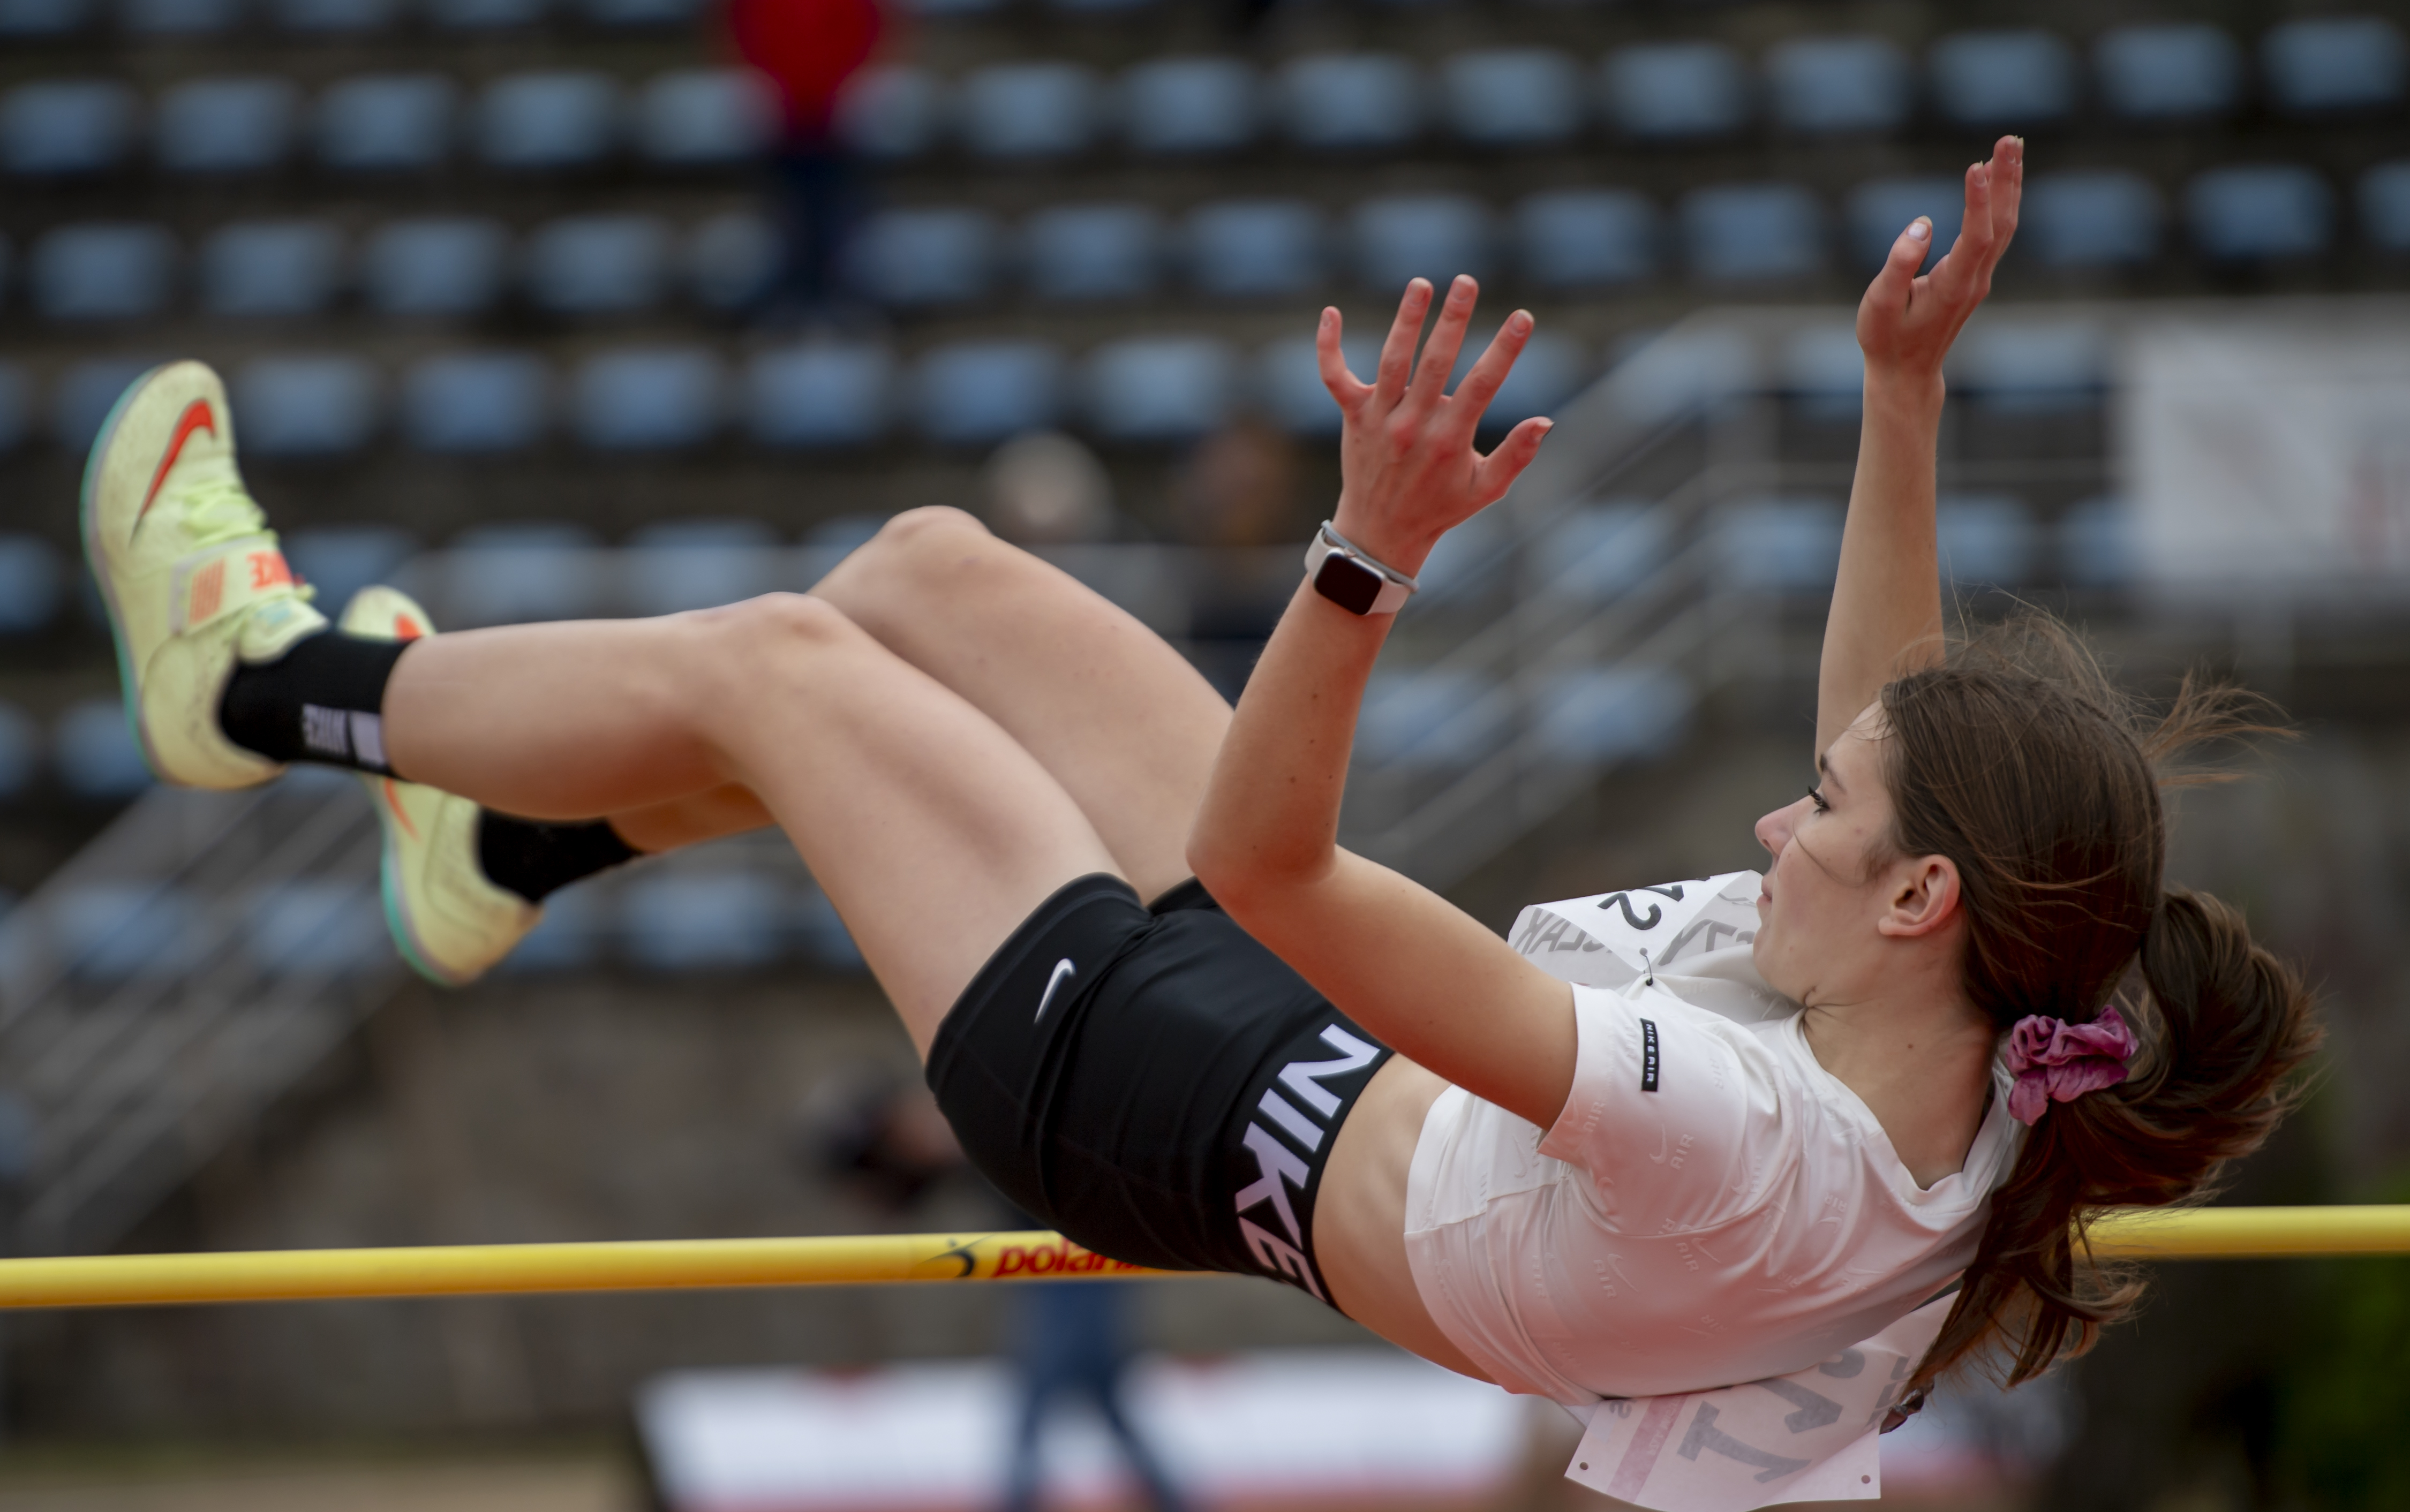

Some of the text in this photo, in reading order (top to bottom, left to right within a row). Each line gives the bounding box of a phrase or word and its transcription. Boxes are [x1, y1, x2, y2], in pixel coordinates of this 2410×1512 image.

[1646, 1024, 1655, 1083] NIKE AIR
[1235, 1023, 1380, 1304] NIKE
[1670, 1133, 1694, 1170] AIR
[1677, 1242, 1699, 1272] AIR
[1594, 1259, 1616, 1299] AIR
